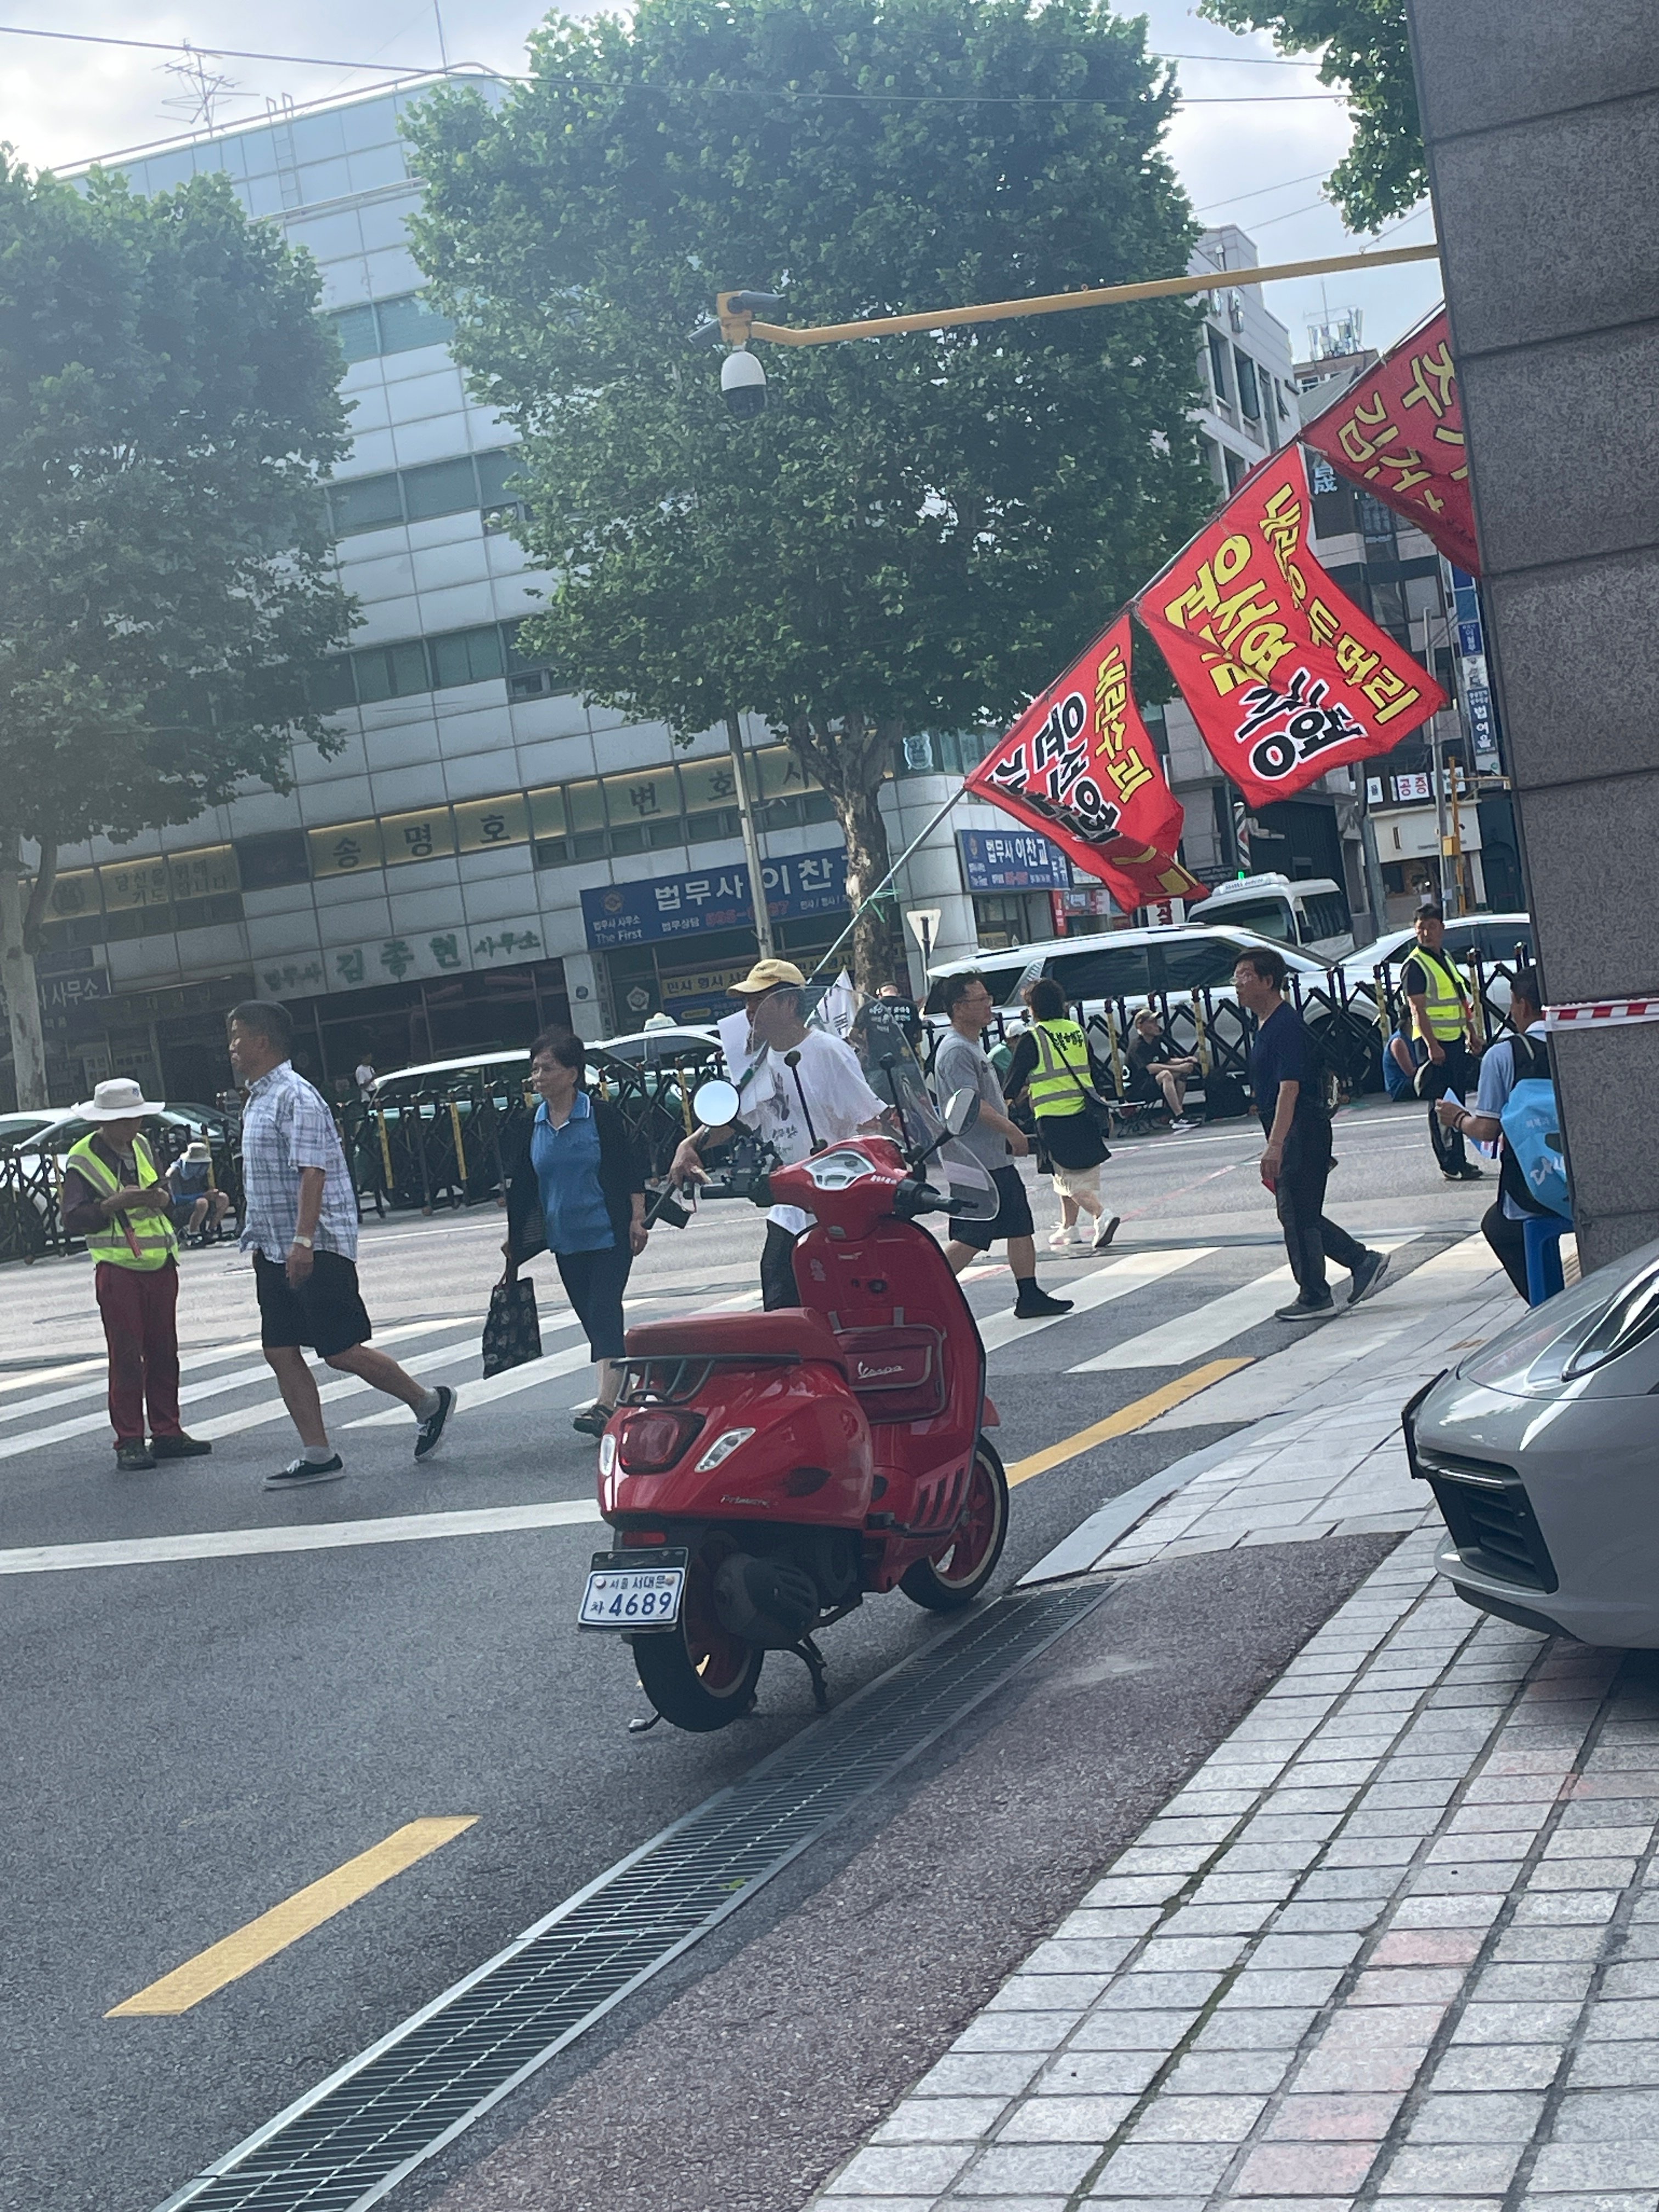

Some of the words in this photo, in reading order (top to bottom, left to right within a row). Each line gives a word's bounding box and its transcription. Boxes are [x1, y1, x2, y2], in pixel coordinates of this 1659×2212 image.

[332, 814, 510, 869] 송명호
[629, 760, 810, 816] 변호사
[985, 839, 1015, 864] 법무사
[653, 874, 744, 911] 법무사
[475, 930, 541, 958] 사무소
[595, 932, 616, 945] The
[617, 928, 642, 943] First
[52, 978, 99, 1008] 사무소
[857, 1361, 905, 1380] Vespa
[609, 1577, 629, 1590] 서울
[632, 1575, 666, 1589] 서대문
[608, 1591, 672, 1617] 4689
